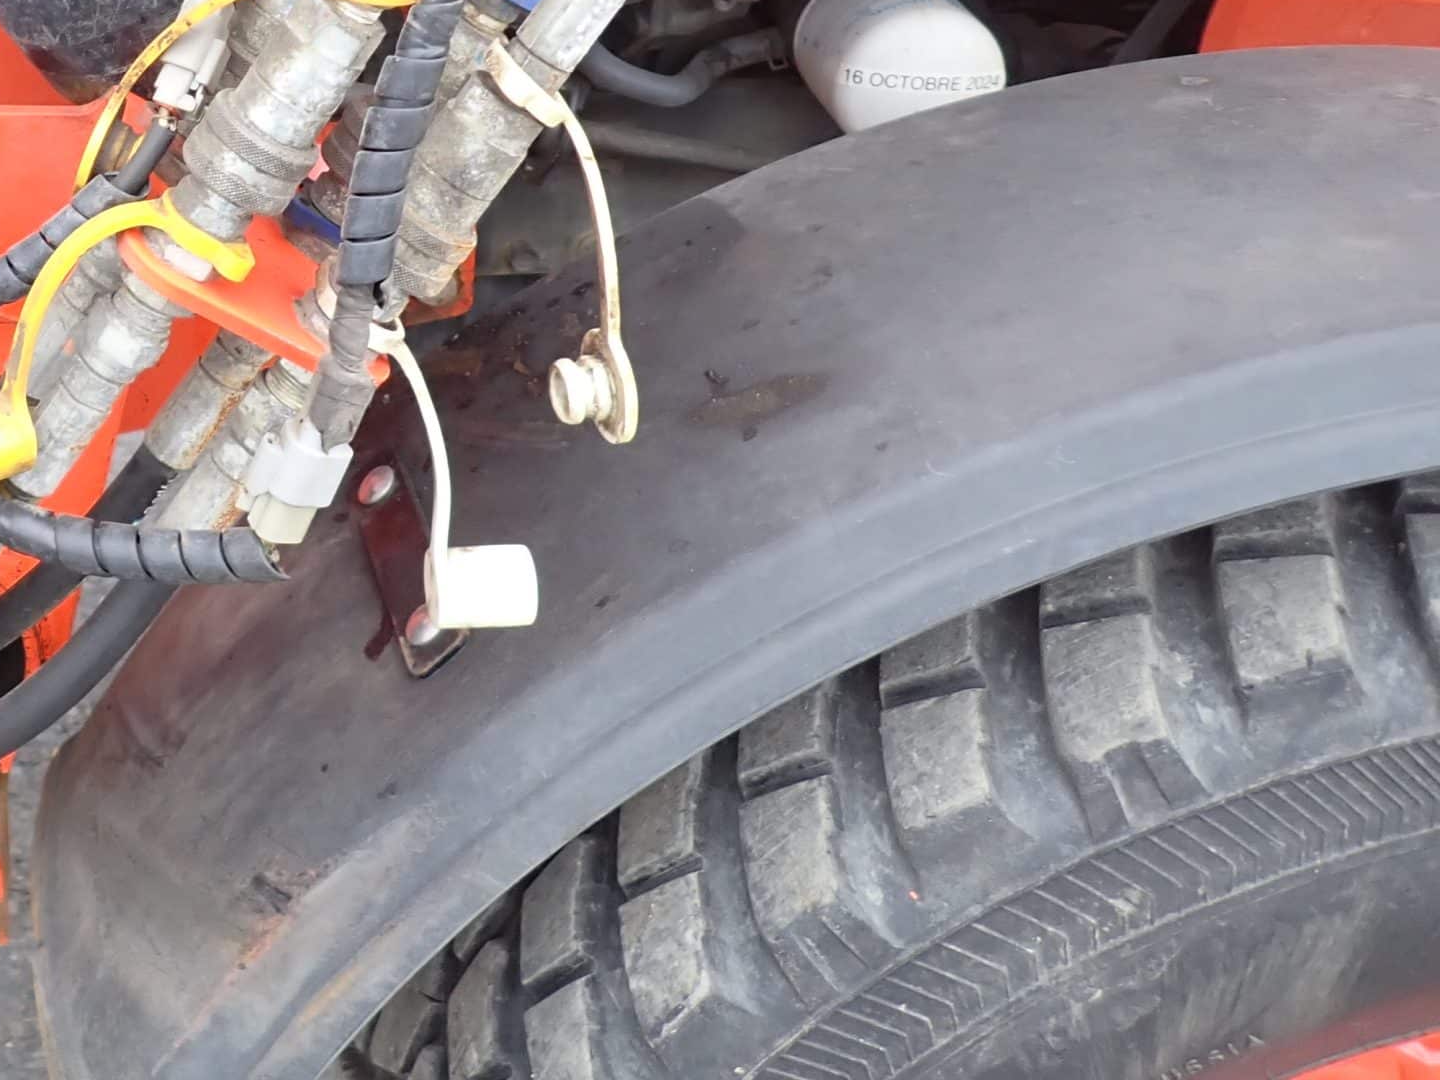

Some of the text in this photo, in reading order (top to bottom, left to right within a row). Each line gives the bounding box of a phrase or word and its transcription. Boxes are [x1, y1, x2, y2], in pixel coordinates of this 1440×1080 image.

[844, 68, 1001, 92] 16 OCTOBRE 2024
